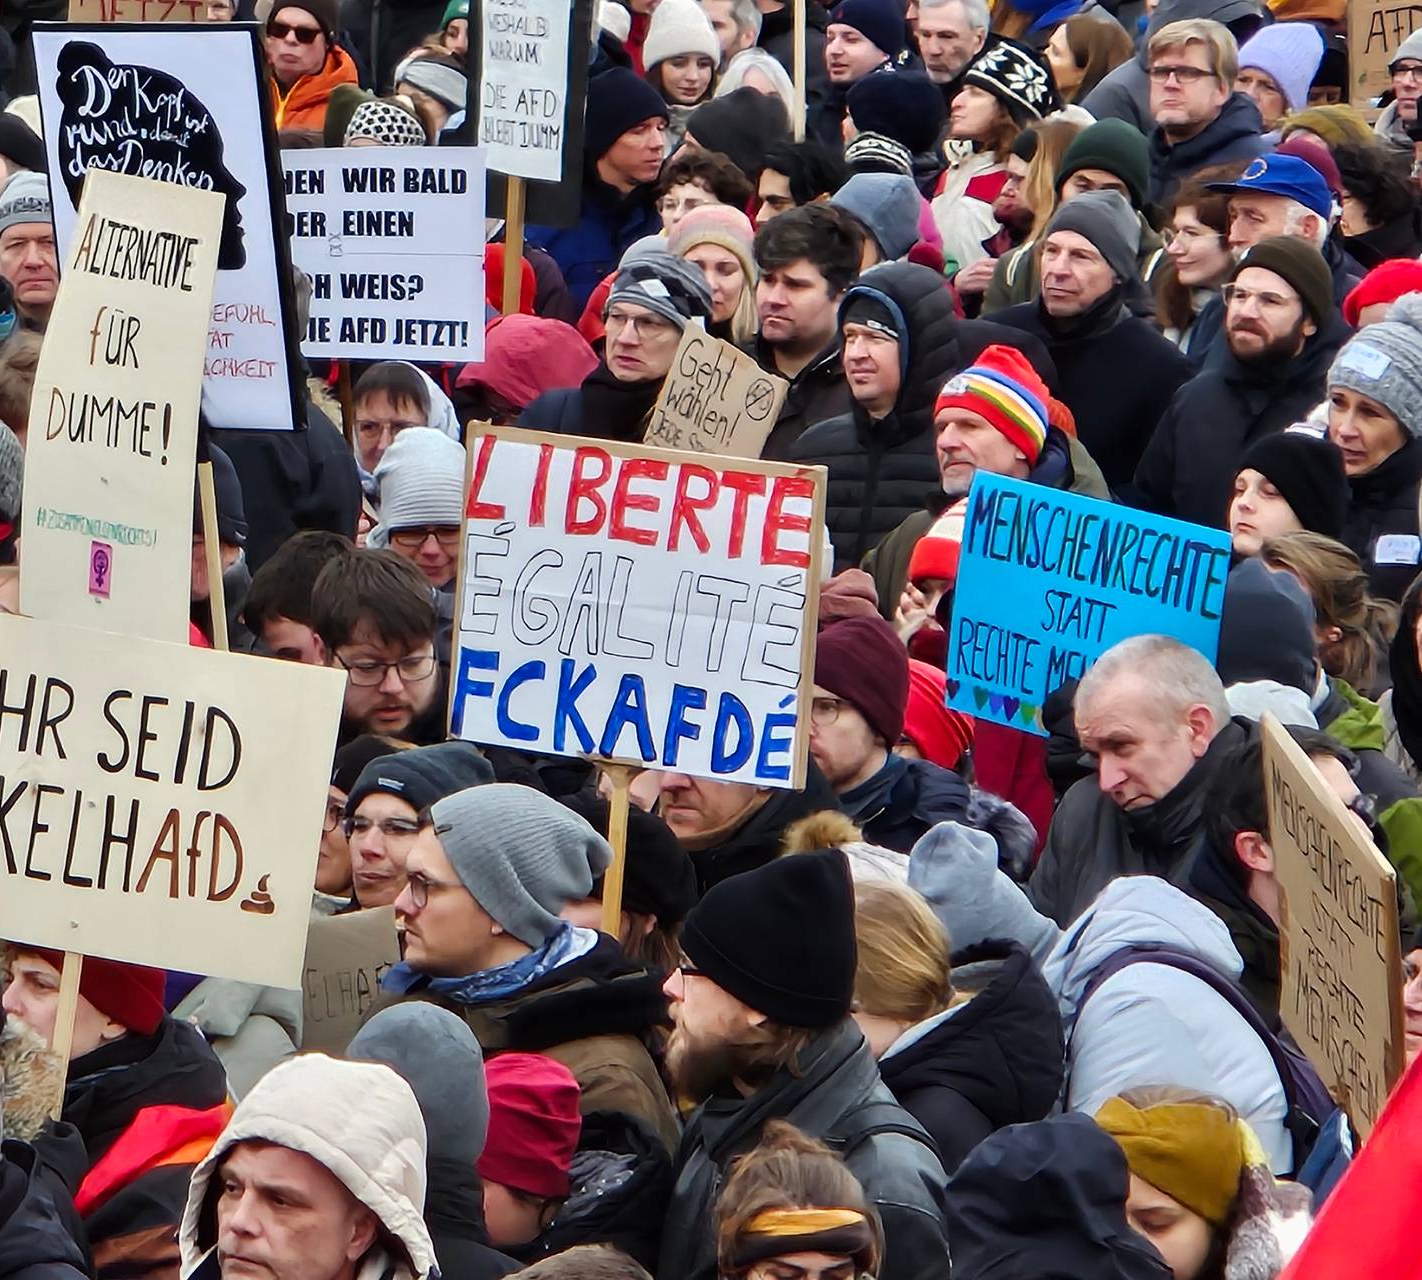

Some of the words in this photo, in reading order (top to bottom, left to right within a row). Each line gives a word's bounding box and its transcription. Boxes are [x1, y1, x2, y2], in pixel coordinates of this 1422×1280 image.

[71, 65, 131, 118] Der
[515, 89, 558, 118] AFD
[342, 167, 395, 194] WIR
[403, 168, 467, 195] BALD
[73, 213, 199, 292] ALTERNATIVE
[343, 210, 414, 237] EINEN
[340, 274, 424, 301] WEIS?
[339, 317, 386, 344] AFD
[393, 318, 468, 348] JETZT!
[680, 338, 738, 401] Geht
[46, 387, 173, 466] DUMME!
[465, 433, 816, 570] LIBERTÉ
[967, 484, 1231, 620] MENSCHENRECHTE
[459, 521, 807, 689] ÉGALITÉ
[1040, 589, 1118, 643] STATT
[956, 616, 1041, 695] RECHTE
[96, 689, 243, 791] SEID
[450, 645, 798, 781] FCKAFDÉ
